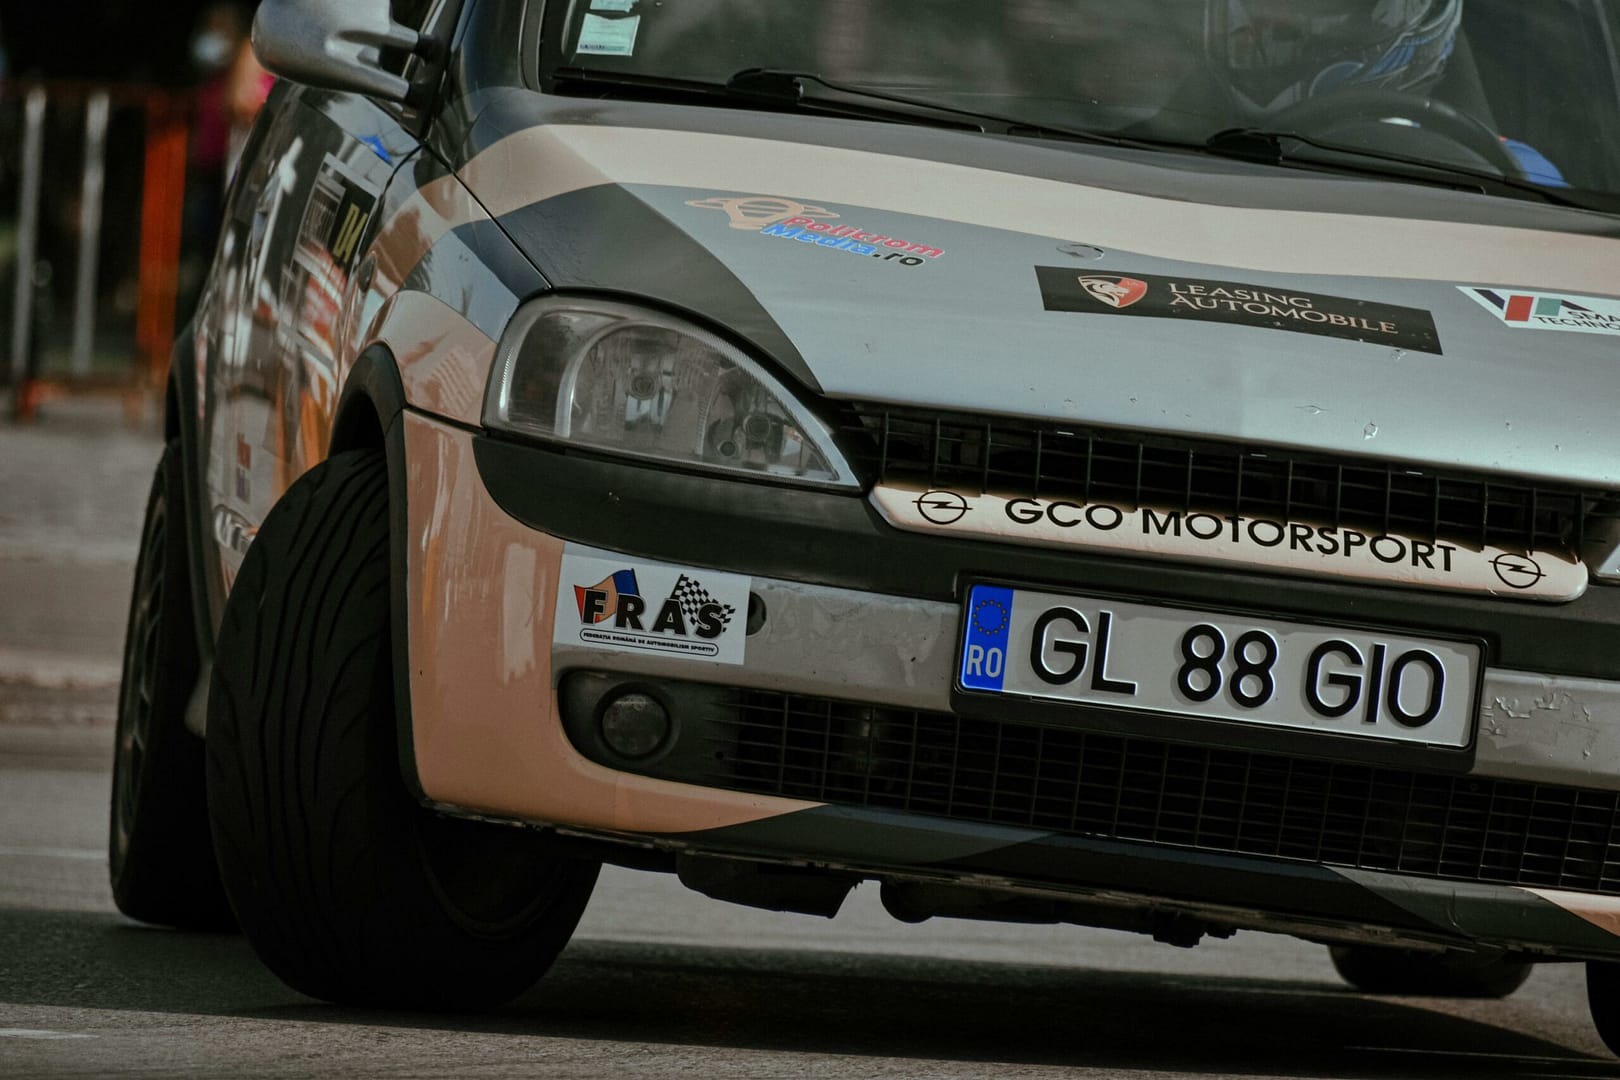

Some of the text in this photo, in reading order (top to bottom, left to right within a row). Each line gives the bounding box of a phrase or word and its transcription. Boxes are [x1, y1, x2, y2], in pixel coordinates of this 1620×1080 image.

[761, 223, 924, 266] Media.ro
[783, 215, 944, 258] Policrom
[1168, 282, 1312, 309] LEASING
[1169, 294, 1399, 334] AUTOMOBILE
[1005, 498, 1457, 571] GCO MOTORSPORT
[582, 590, 724, 639] FRAS
[967, 642, 1002, 678] RO
[1030, 606, 1446, 728] GL 88 GIO
